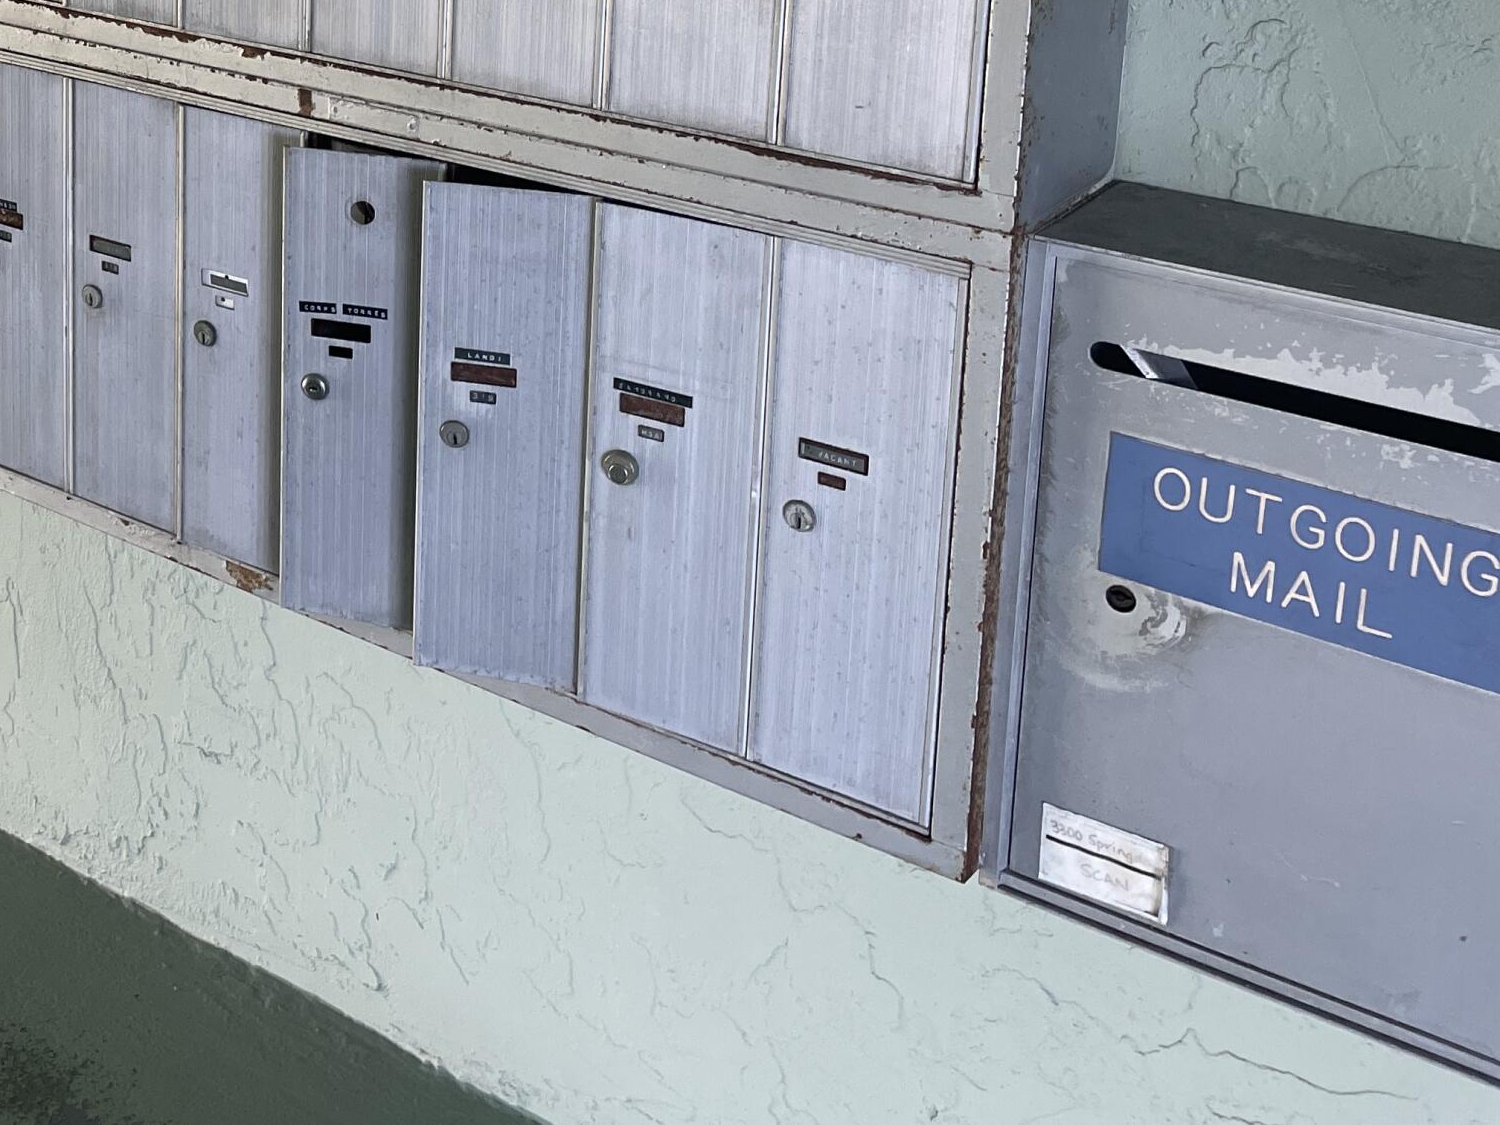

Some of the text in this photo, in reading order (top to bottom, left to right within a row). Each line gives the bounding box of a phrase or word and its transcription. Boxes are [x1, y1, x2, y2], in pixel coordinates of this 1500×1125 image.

[304, 304, 386, 318] CORPS TORRES
[467, 352, 502, 362] LANDI
[818, 451, 857, 467] VACANT
[1153, 466, 1500, 598] OUTGOING
[1229, 551, 1393, 639] MAIL
[1050, 819, 1083, 841] 3300
[1079, 863, 1129, 892] SCAN
